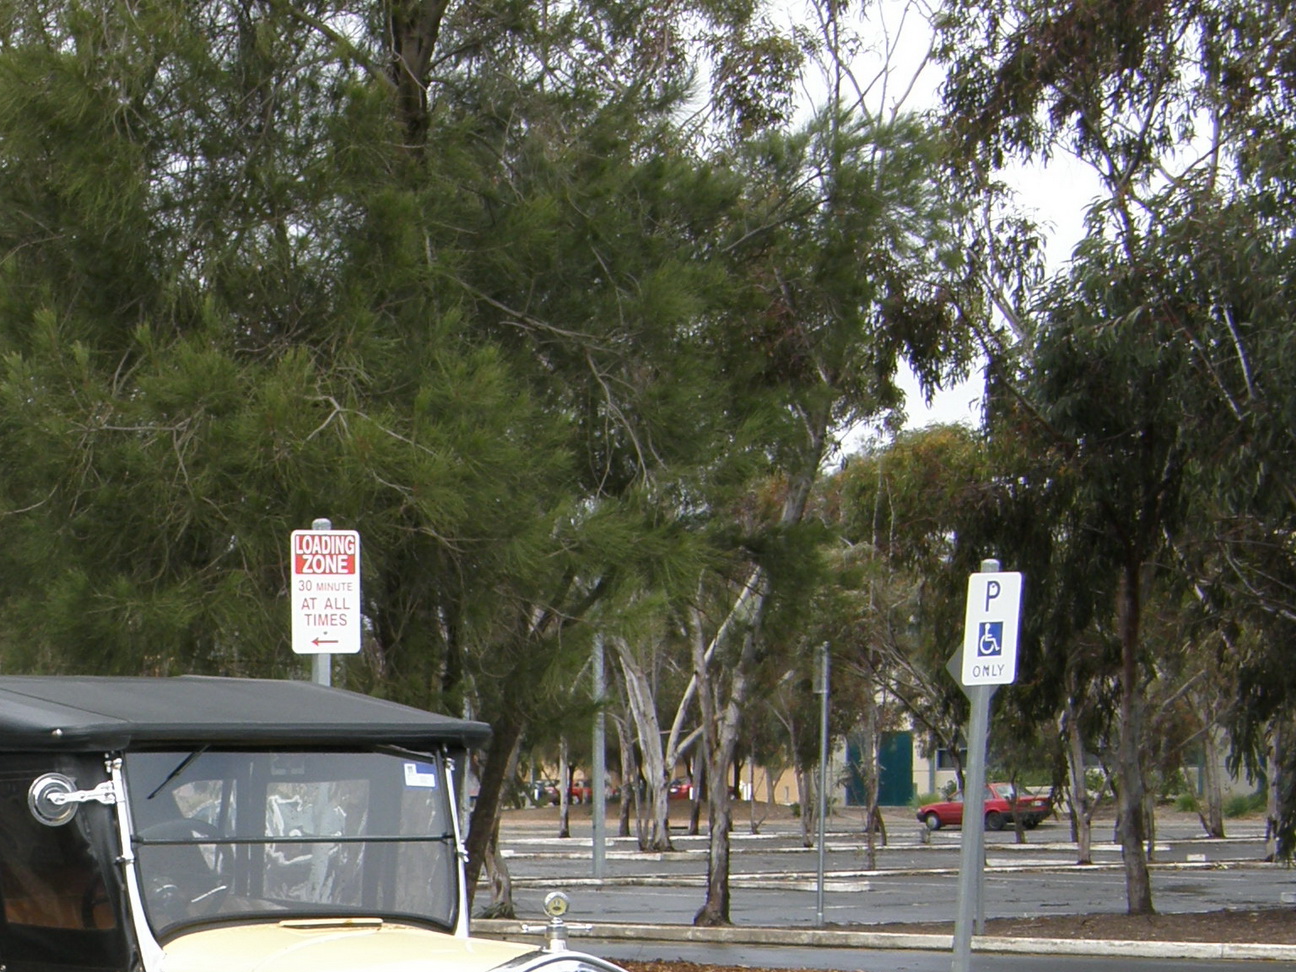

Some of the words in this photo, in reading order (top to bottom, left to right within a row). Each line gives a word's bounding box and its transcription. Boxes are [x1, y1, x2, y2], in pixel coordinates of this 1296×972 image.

[295, 535, 355, 555] LOADING
[302, 554, 349, 574] ZONE
[298, 580, 313, 591] 30
[316, 582, 353, 591] MINUTE
[985, 580, 1001, 612] P
[301, 597, 317, 610] AT
[324, 597, 350, 610] ALL
[304, 613, 347, 626] TIMES
[972, 664, 1005, 677] ONLY
